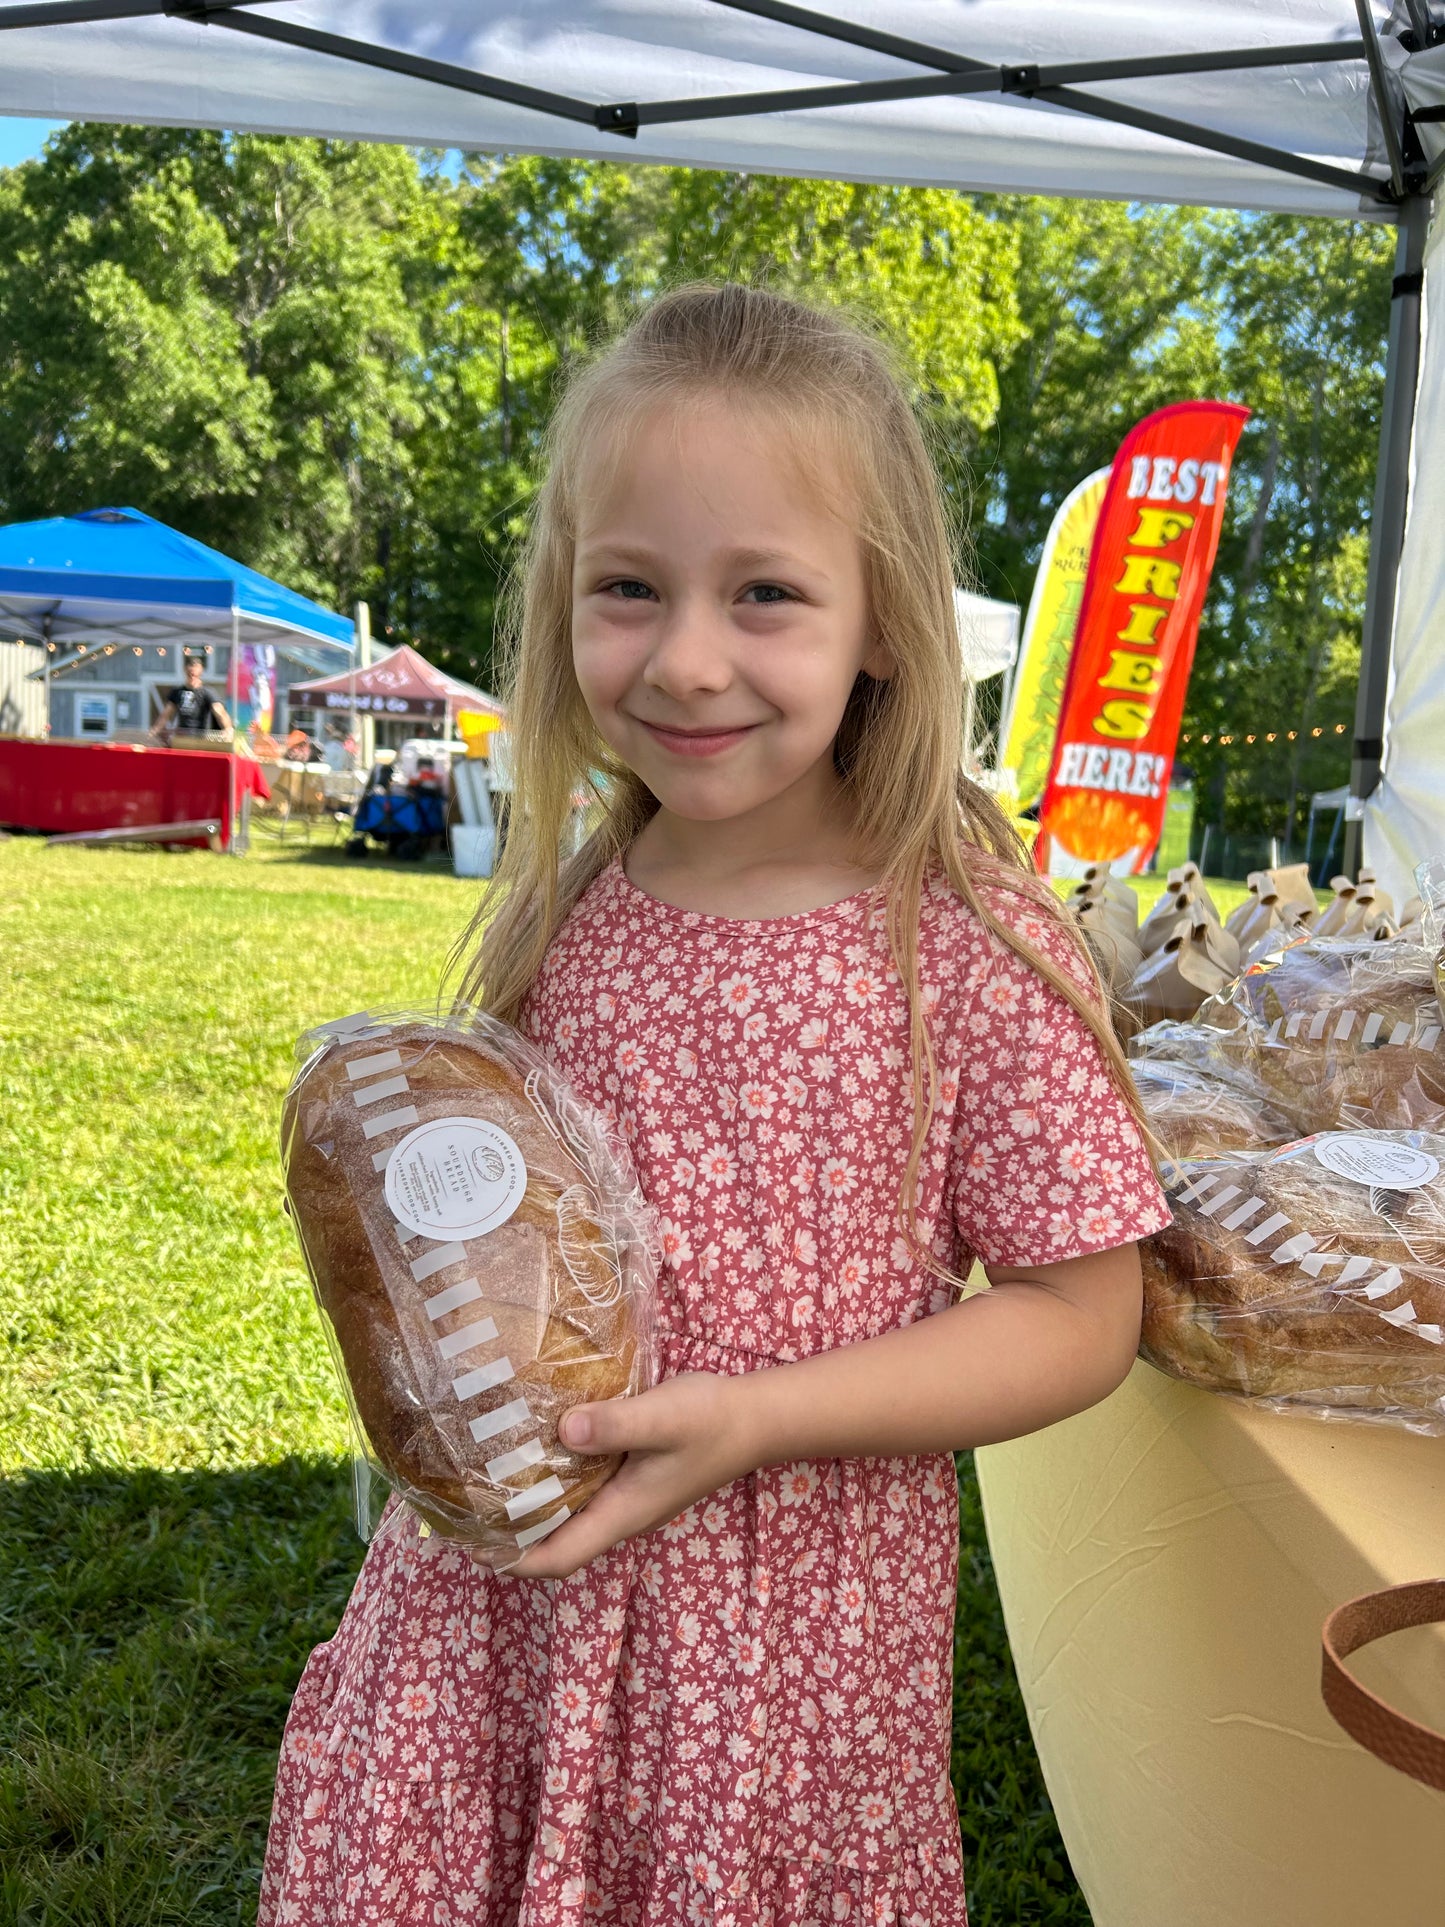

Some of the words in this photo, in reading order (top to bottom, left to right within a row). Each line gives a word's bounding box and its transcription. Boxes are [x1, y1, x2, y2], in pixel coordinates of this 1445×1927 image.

[1127, 455, 1225, 505] BEST
[1092, 506, 1194, 739] FRIES
[1055, 742, 1165, 798] HERE!
[443, 1160, 460, 1192] BREAD
[448, 1144, 473, 1203] SOURDOUGH
